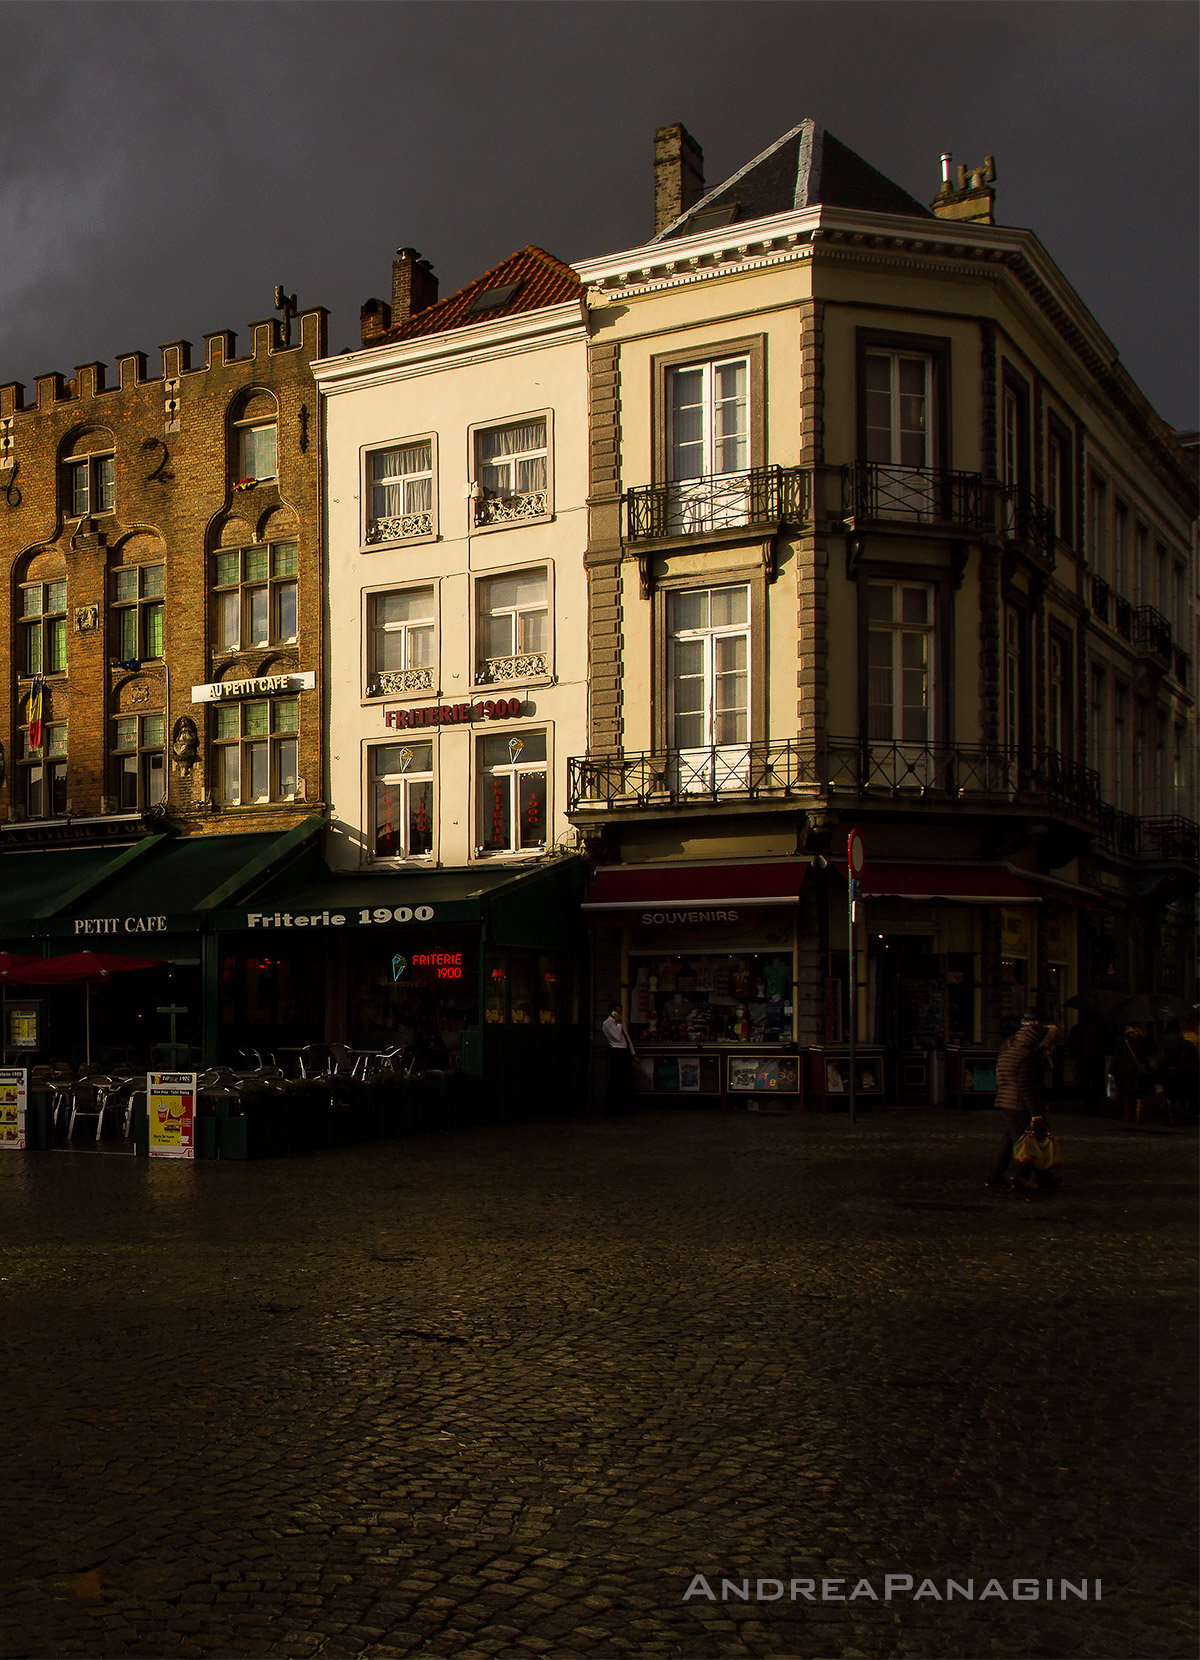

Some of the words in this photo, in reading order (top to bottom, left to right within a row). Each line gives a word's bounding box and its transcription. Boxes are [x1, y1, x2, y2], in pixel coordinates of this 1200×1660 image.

[210, 684, 223, 697] AU
[224, 679, 258, 696] PETIT
[385, 703, 470, 728] FRITERIE
[476, 697, 520, 717] 1900
[107, 818, 149, 835] D'OR
[247, 910, 347, 928] Friterie
[358, 905, 435, 924] 1900
[641, 910, 739, 925] SOUVENIRS
[74, 918, 120, 935] PETIT
[124, 916, 168, 932] CAFE
[412, 953, 463, 966] FRITERIE
[437, 967, 462, 979] 1900
